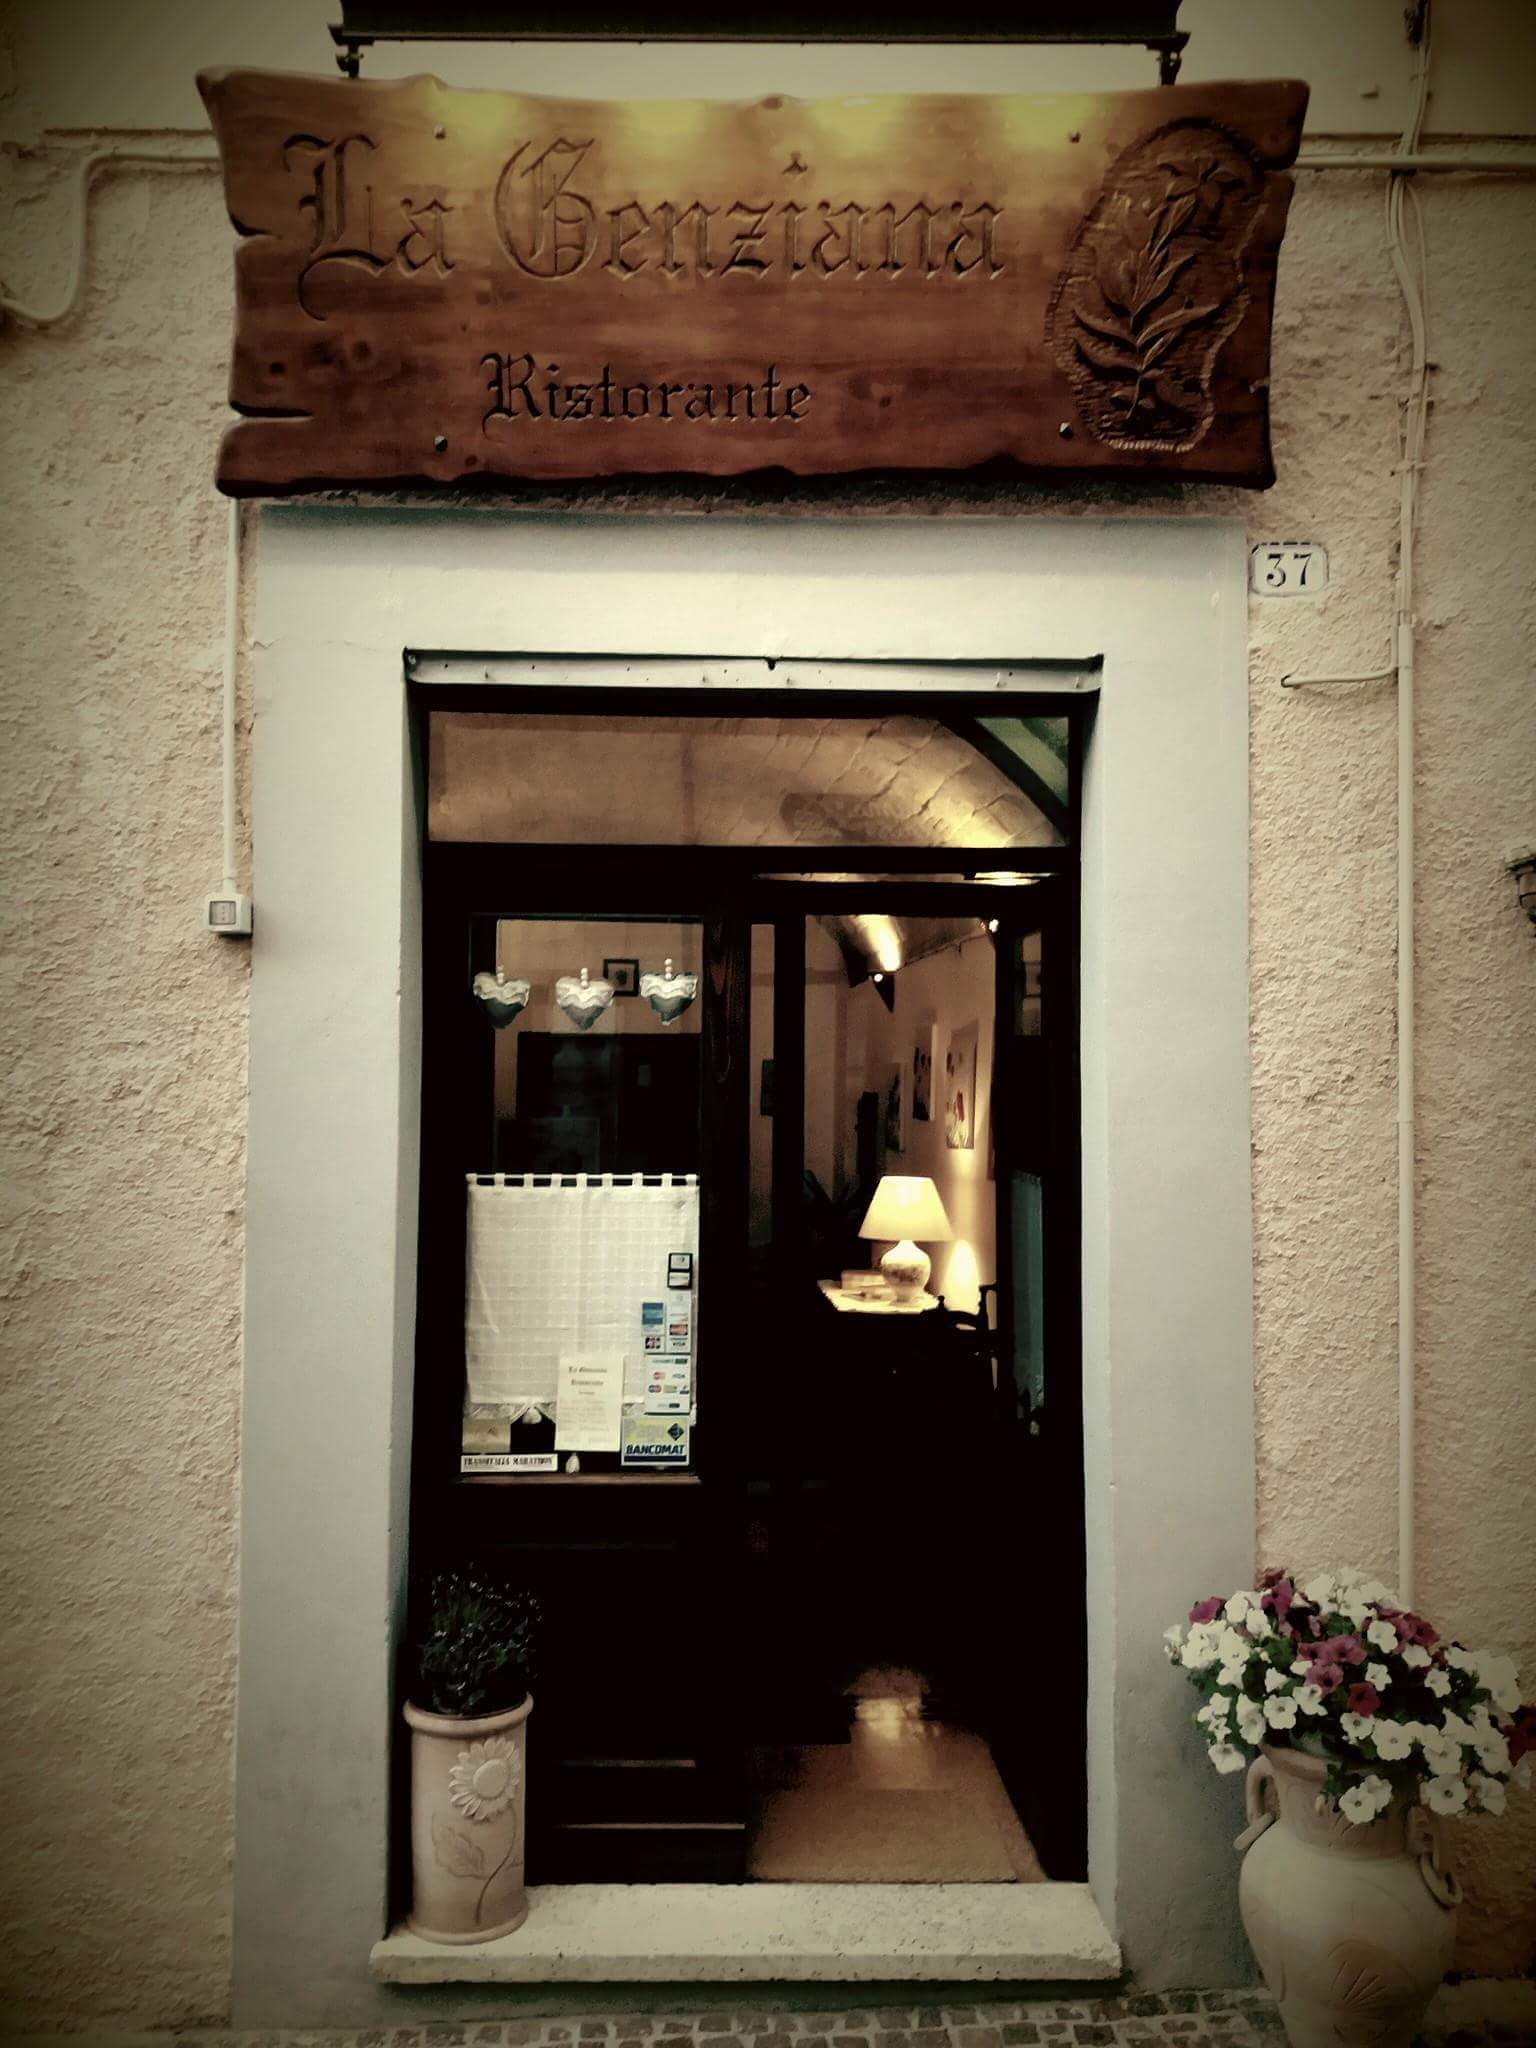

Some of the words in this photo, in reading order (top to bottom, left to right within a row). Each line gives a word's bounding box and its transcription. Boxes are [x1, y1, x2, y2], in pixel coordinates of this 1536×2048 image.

[282, 133, 456, 321] La
[495, 138, 1004, 280] Genziana
[480, 351, 812, 442] Ristorante
[1266, 553, 1312, 588] 37
[626, 1444, 685, 1455] BANCOMAT
